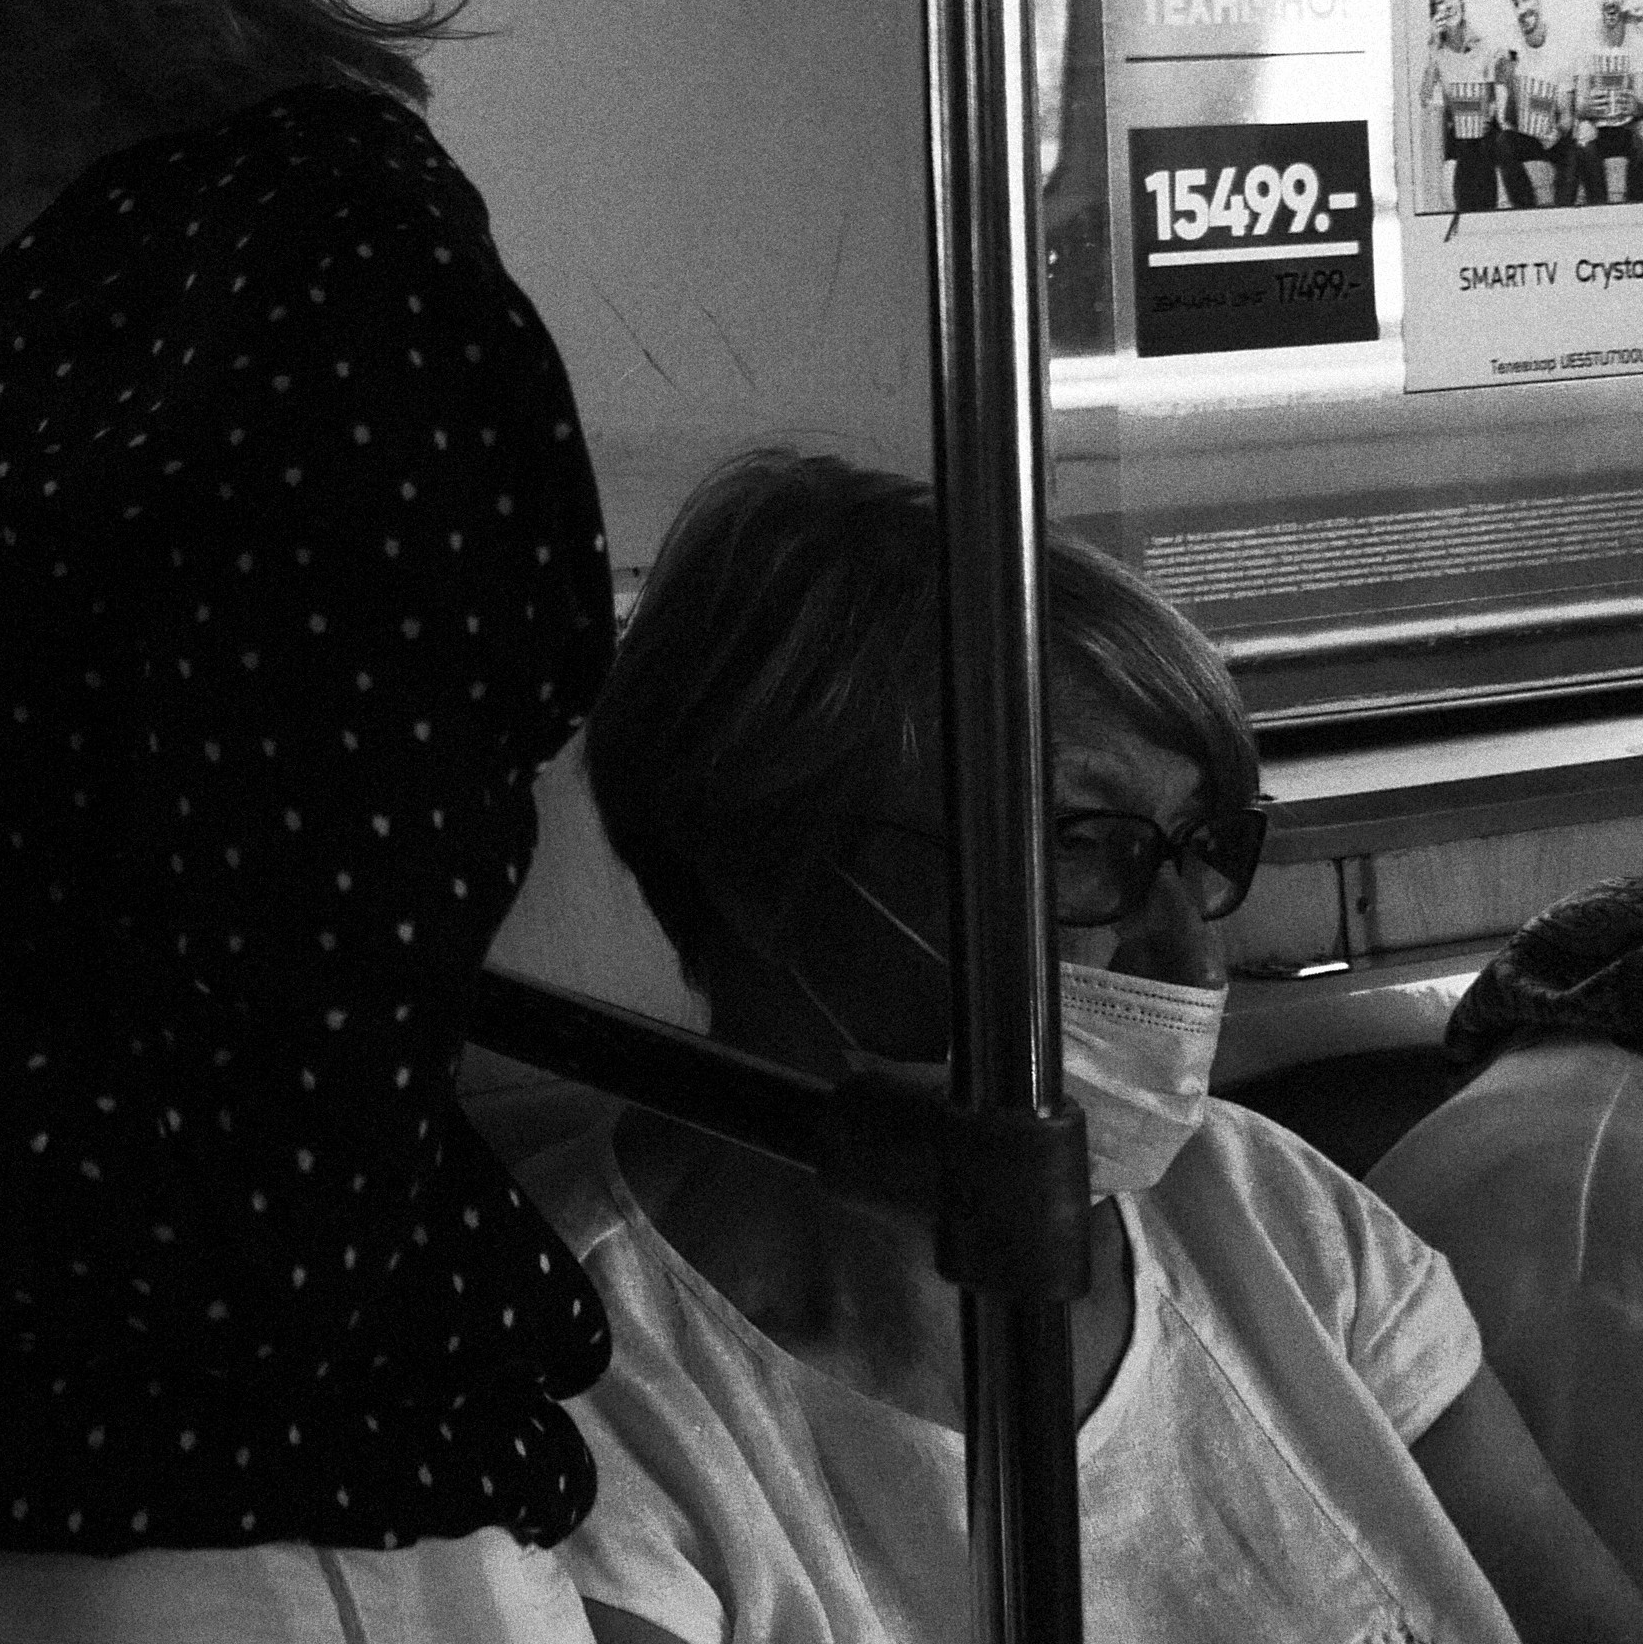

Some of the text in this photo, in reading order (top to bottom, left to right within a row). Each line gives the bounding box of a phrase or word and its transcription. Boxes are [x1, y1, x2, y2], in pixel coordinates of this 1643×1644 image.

[1144, 162, 1359, 241] 15499.-
[1458, 263, 1529, 291] SMART
[1532, 261, 1558, 285] TV
